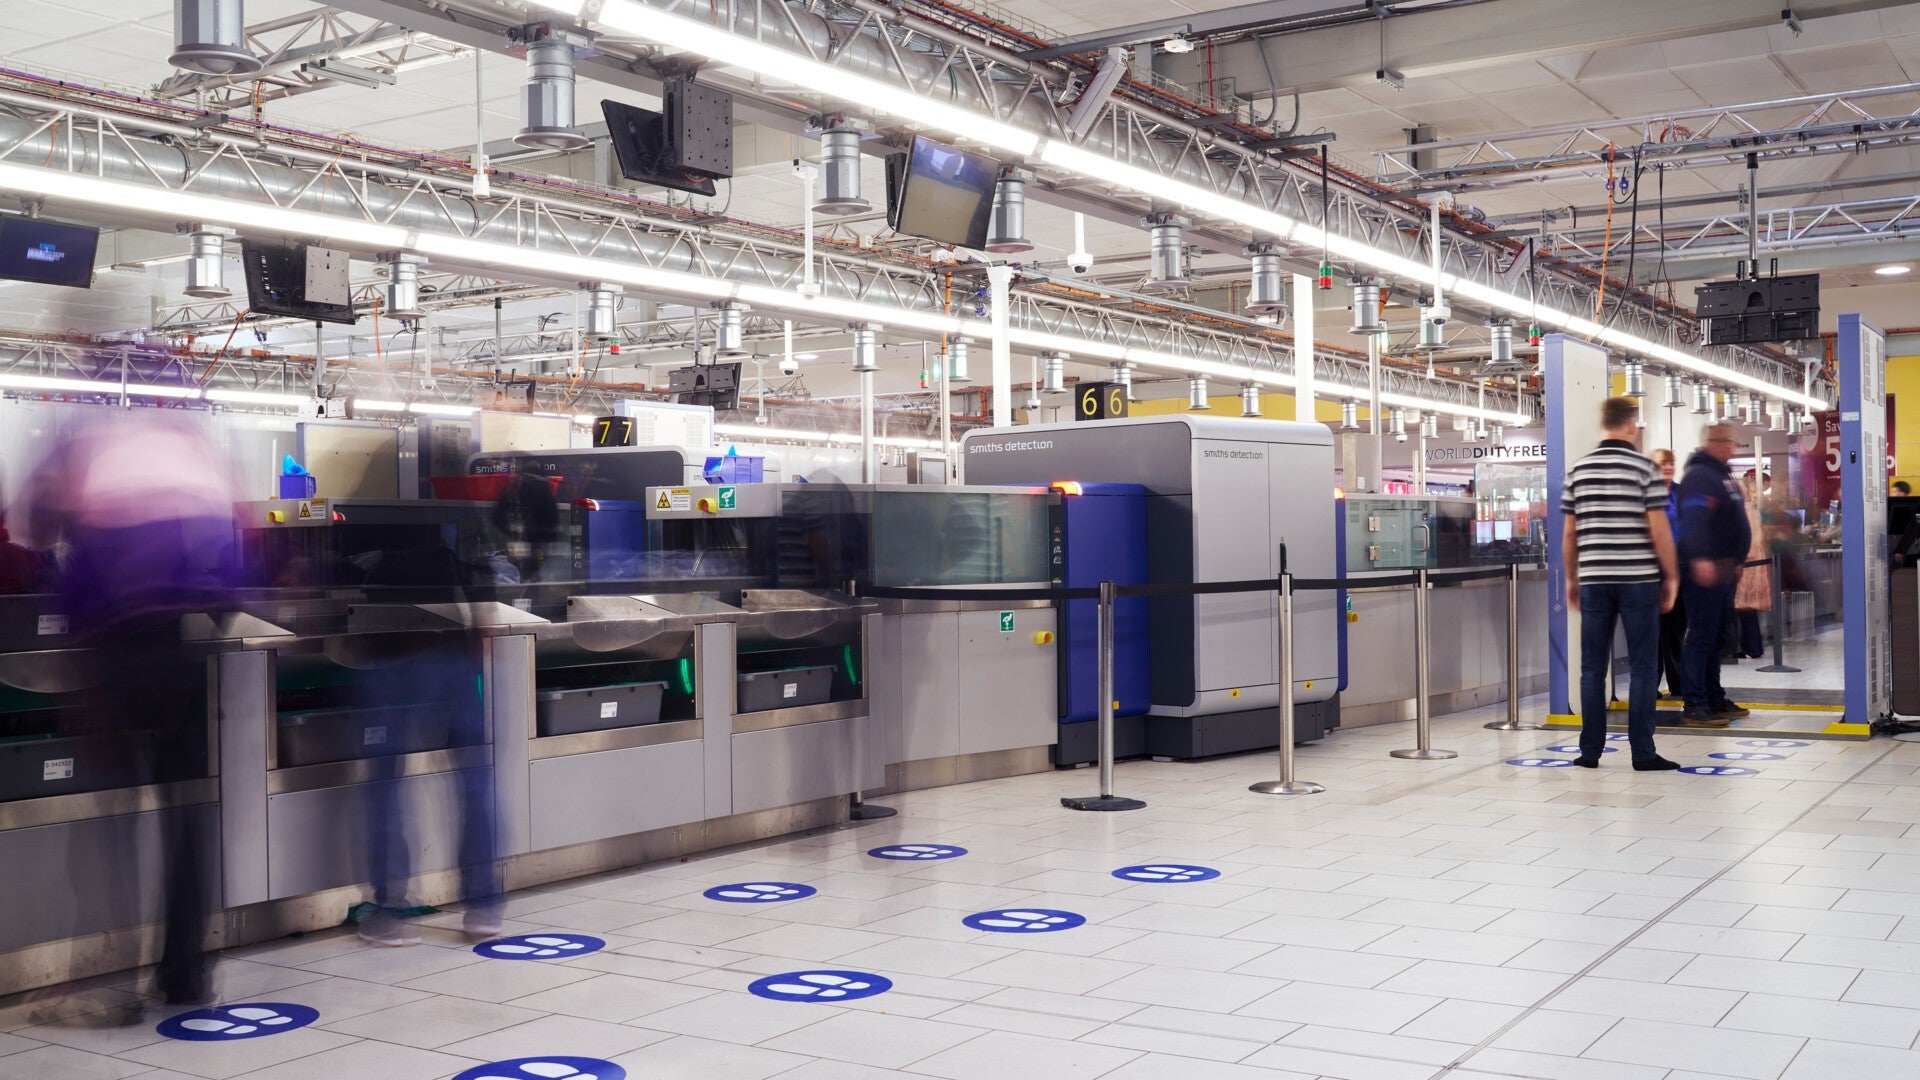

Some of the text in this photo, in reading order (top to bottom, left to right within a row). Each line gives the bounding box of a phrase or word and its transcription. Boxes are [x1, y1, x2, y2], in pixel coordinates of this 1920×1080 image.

[1082, 387, 1098, 416] 6
[1110, 387, 1123, 416] 6
[598, 420, 611, 444] 7
[622, 420, 632, 444] 7
[970, 440, 1053, 454] smiths detection
[1204, 449, 1264, 460] smiths detection
